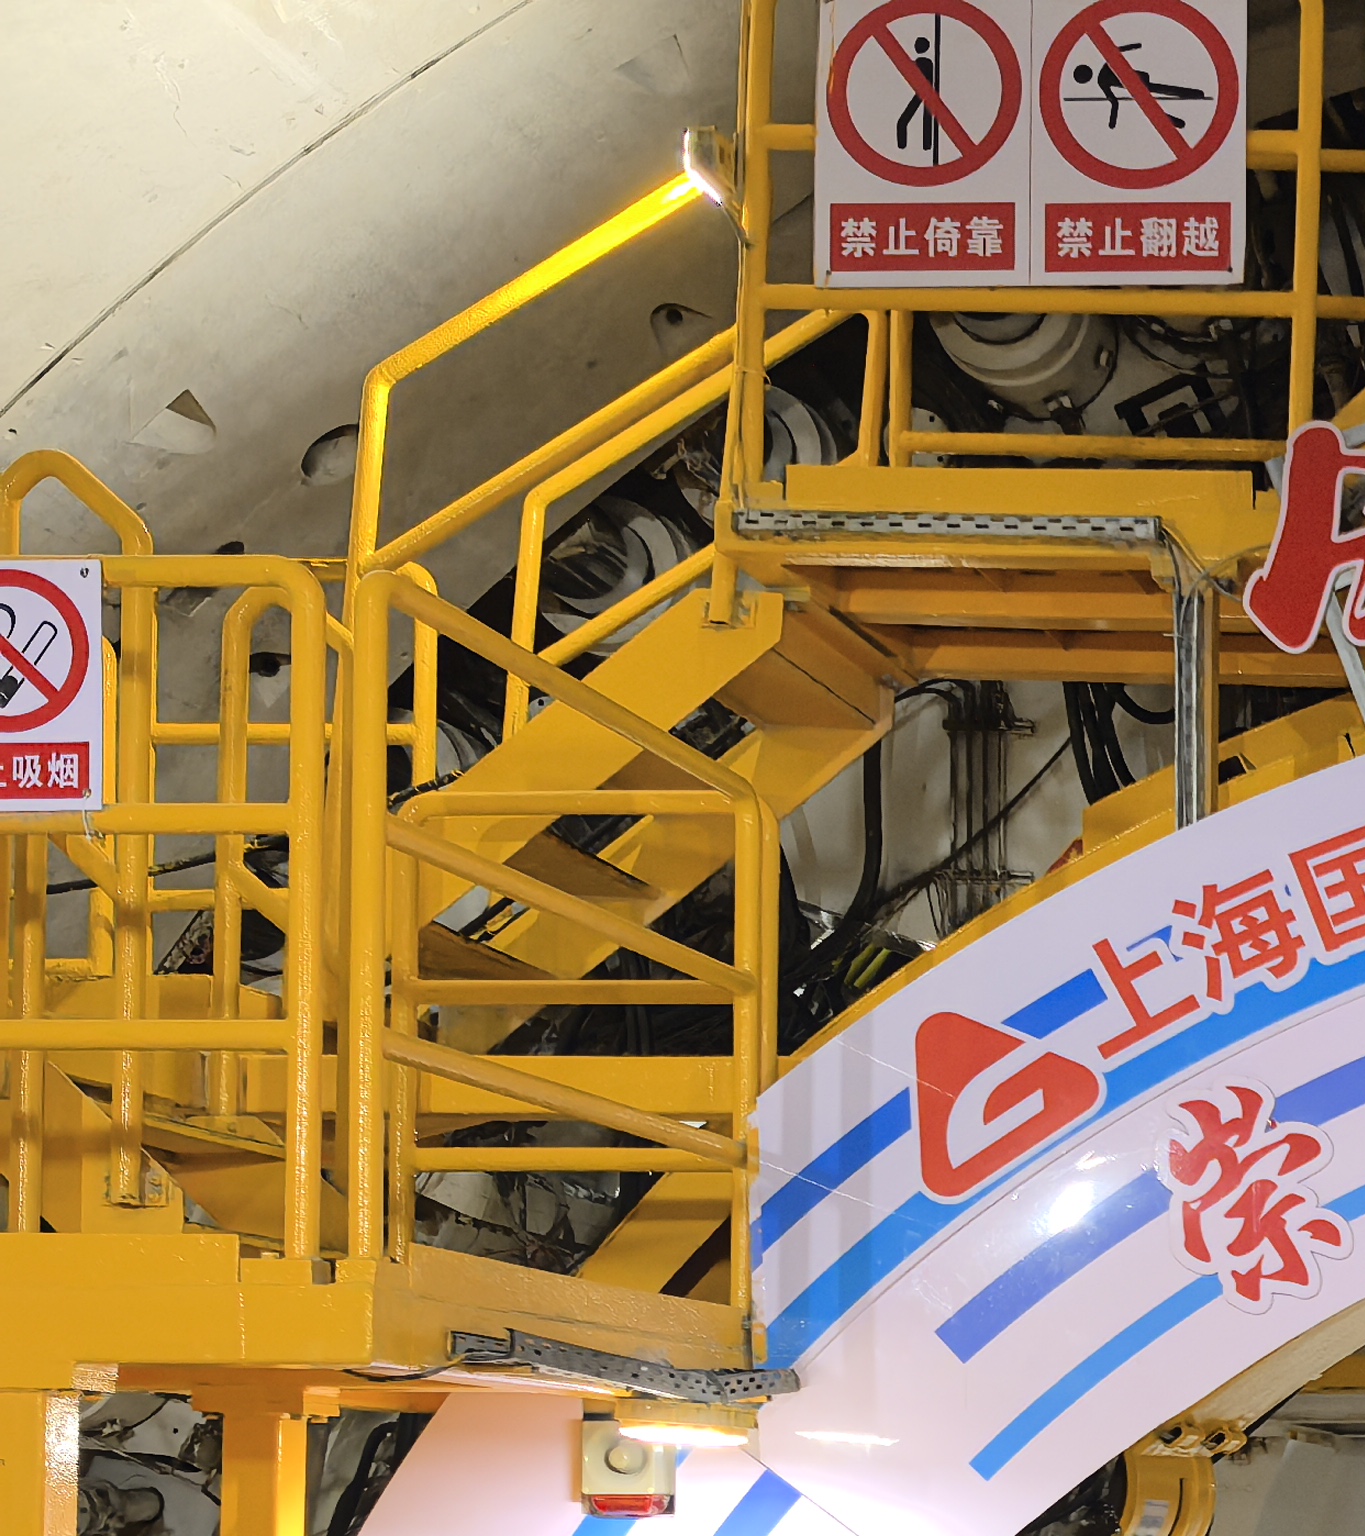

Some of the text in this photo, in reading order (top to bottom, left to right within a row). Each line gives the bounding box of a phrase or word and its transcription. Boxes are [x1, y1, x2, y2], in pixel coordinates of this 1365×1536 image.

[841, 217, 1004, 259] 禁止倚靠
[1056, 216, 1220, 259] 禁止翻越
[0, 752, 79, 788] 吸烟
